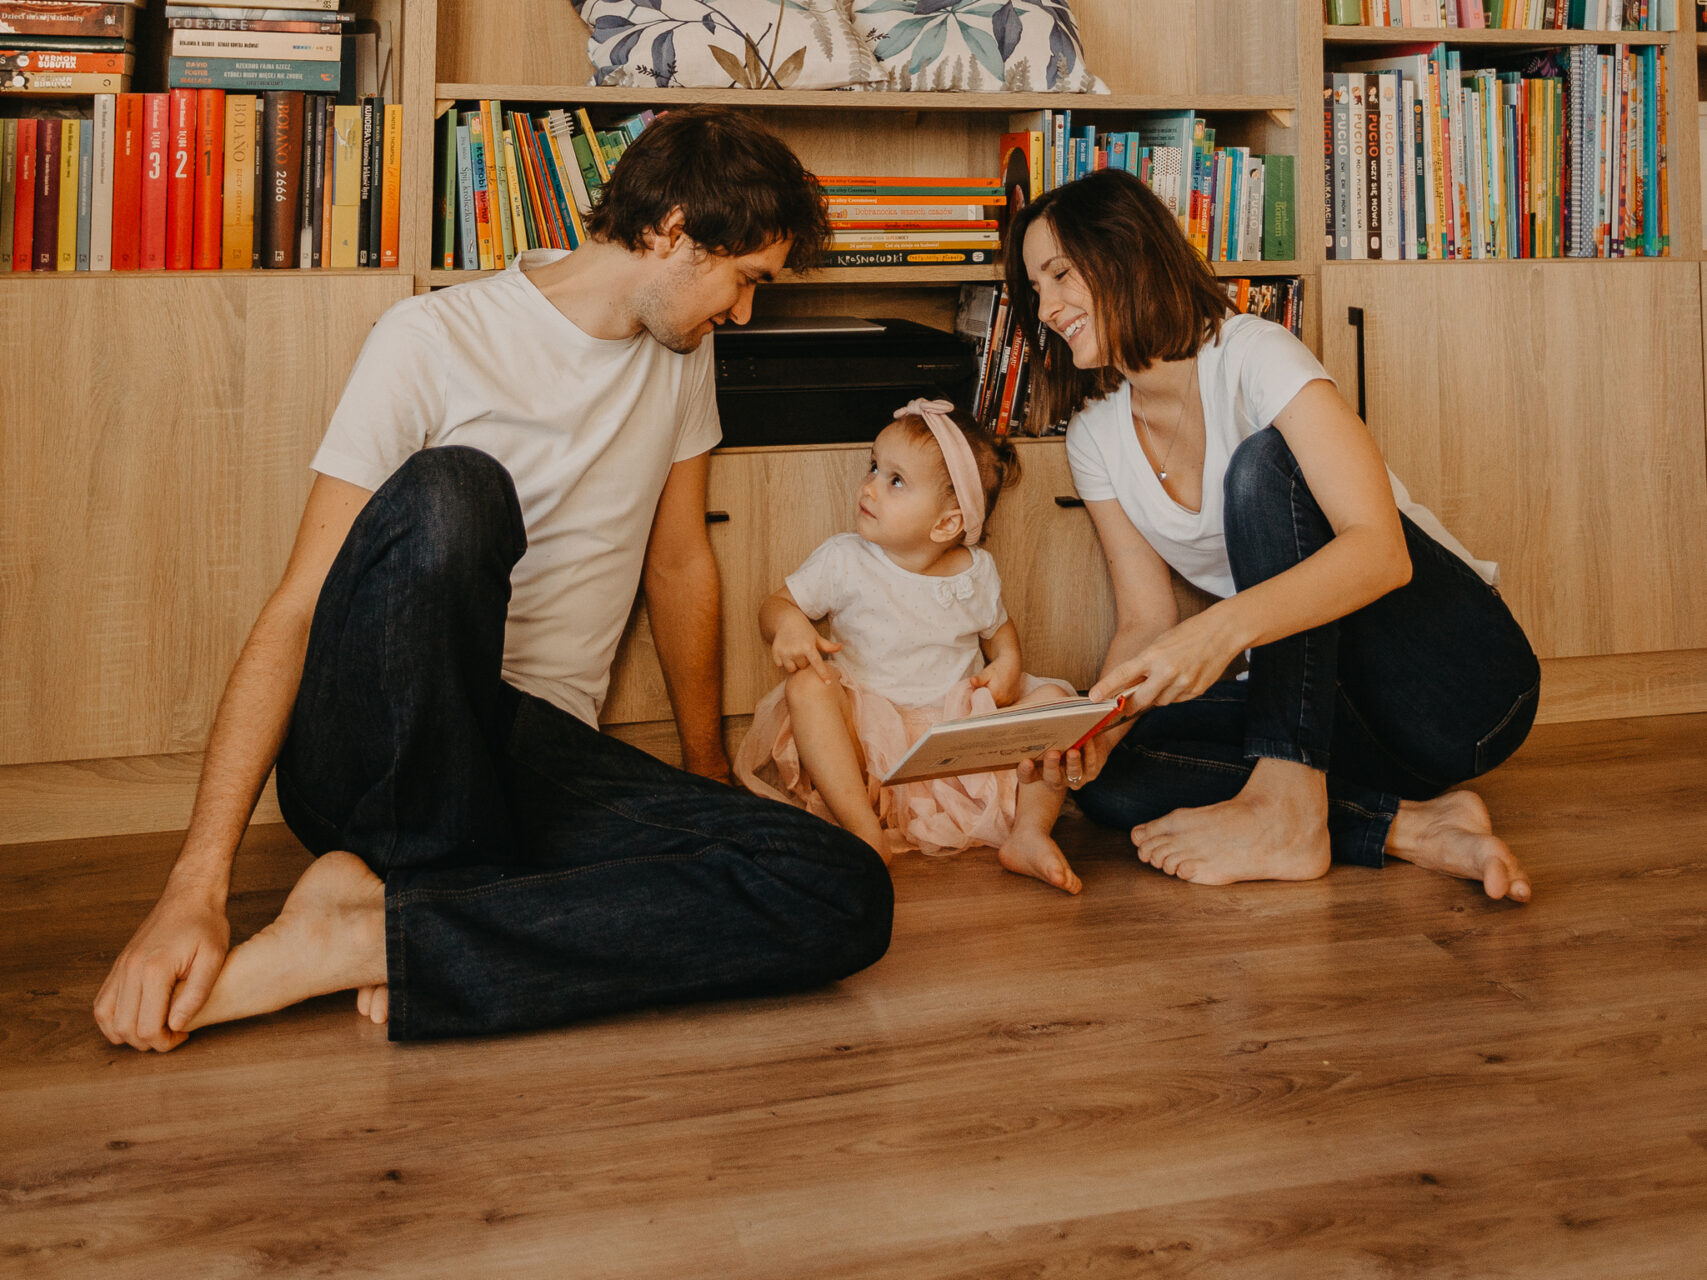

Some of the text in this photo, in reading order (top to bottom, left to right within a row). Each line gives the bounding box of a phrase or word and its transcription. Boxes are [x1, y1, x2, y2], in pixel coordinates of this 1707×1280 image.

[233, 104, 250, 161] BOLAÑO
[364, 105, 372, 138] KUNDERA
[149, 152, 160, 179] 3
[175, 151, 187, 178] 2
[205, 150, 211, 176] 1
[276, 103, 292, 202] BOLAÑO 2666
